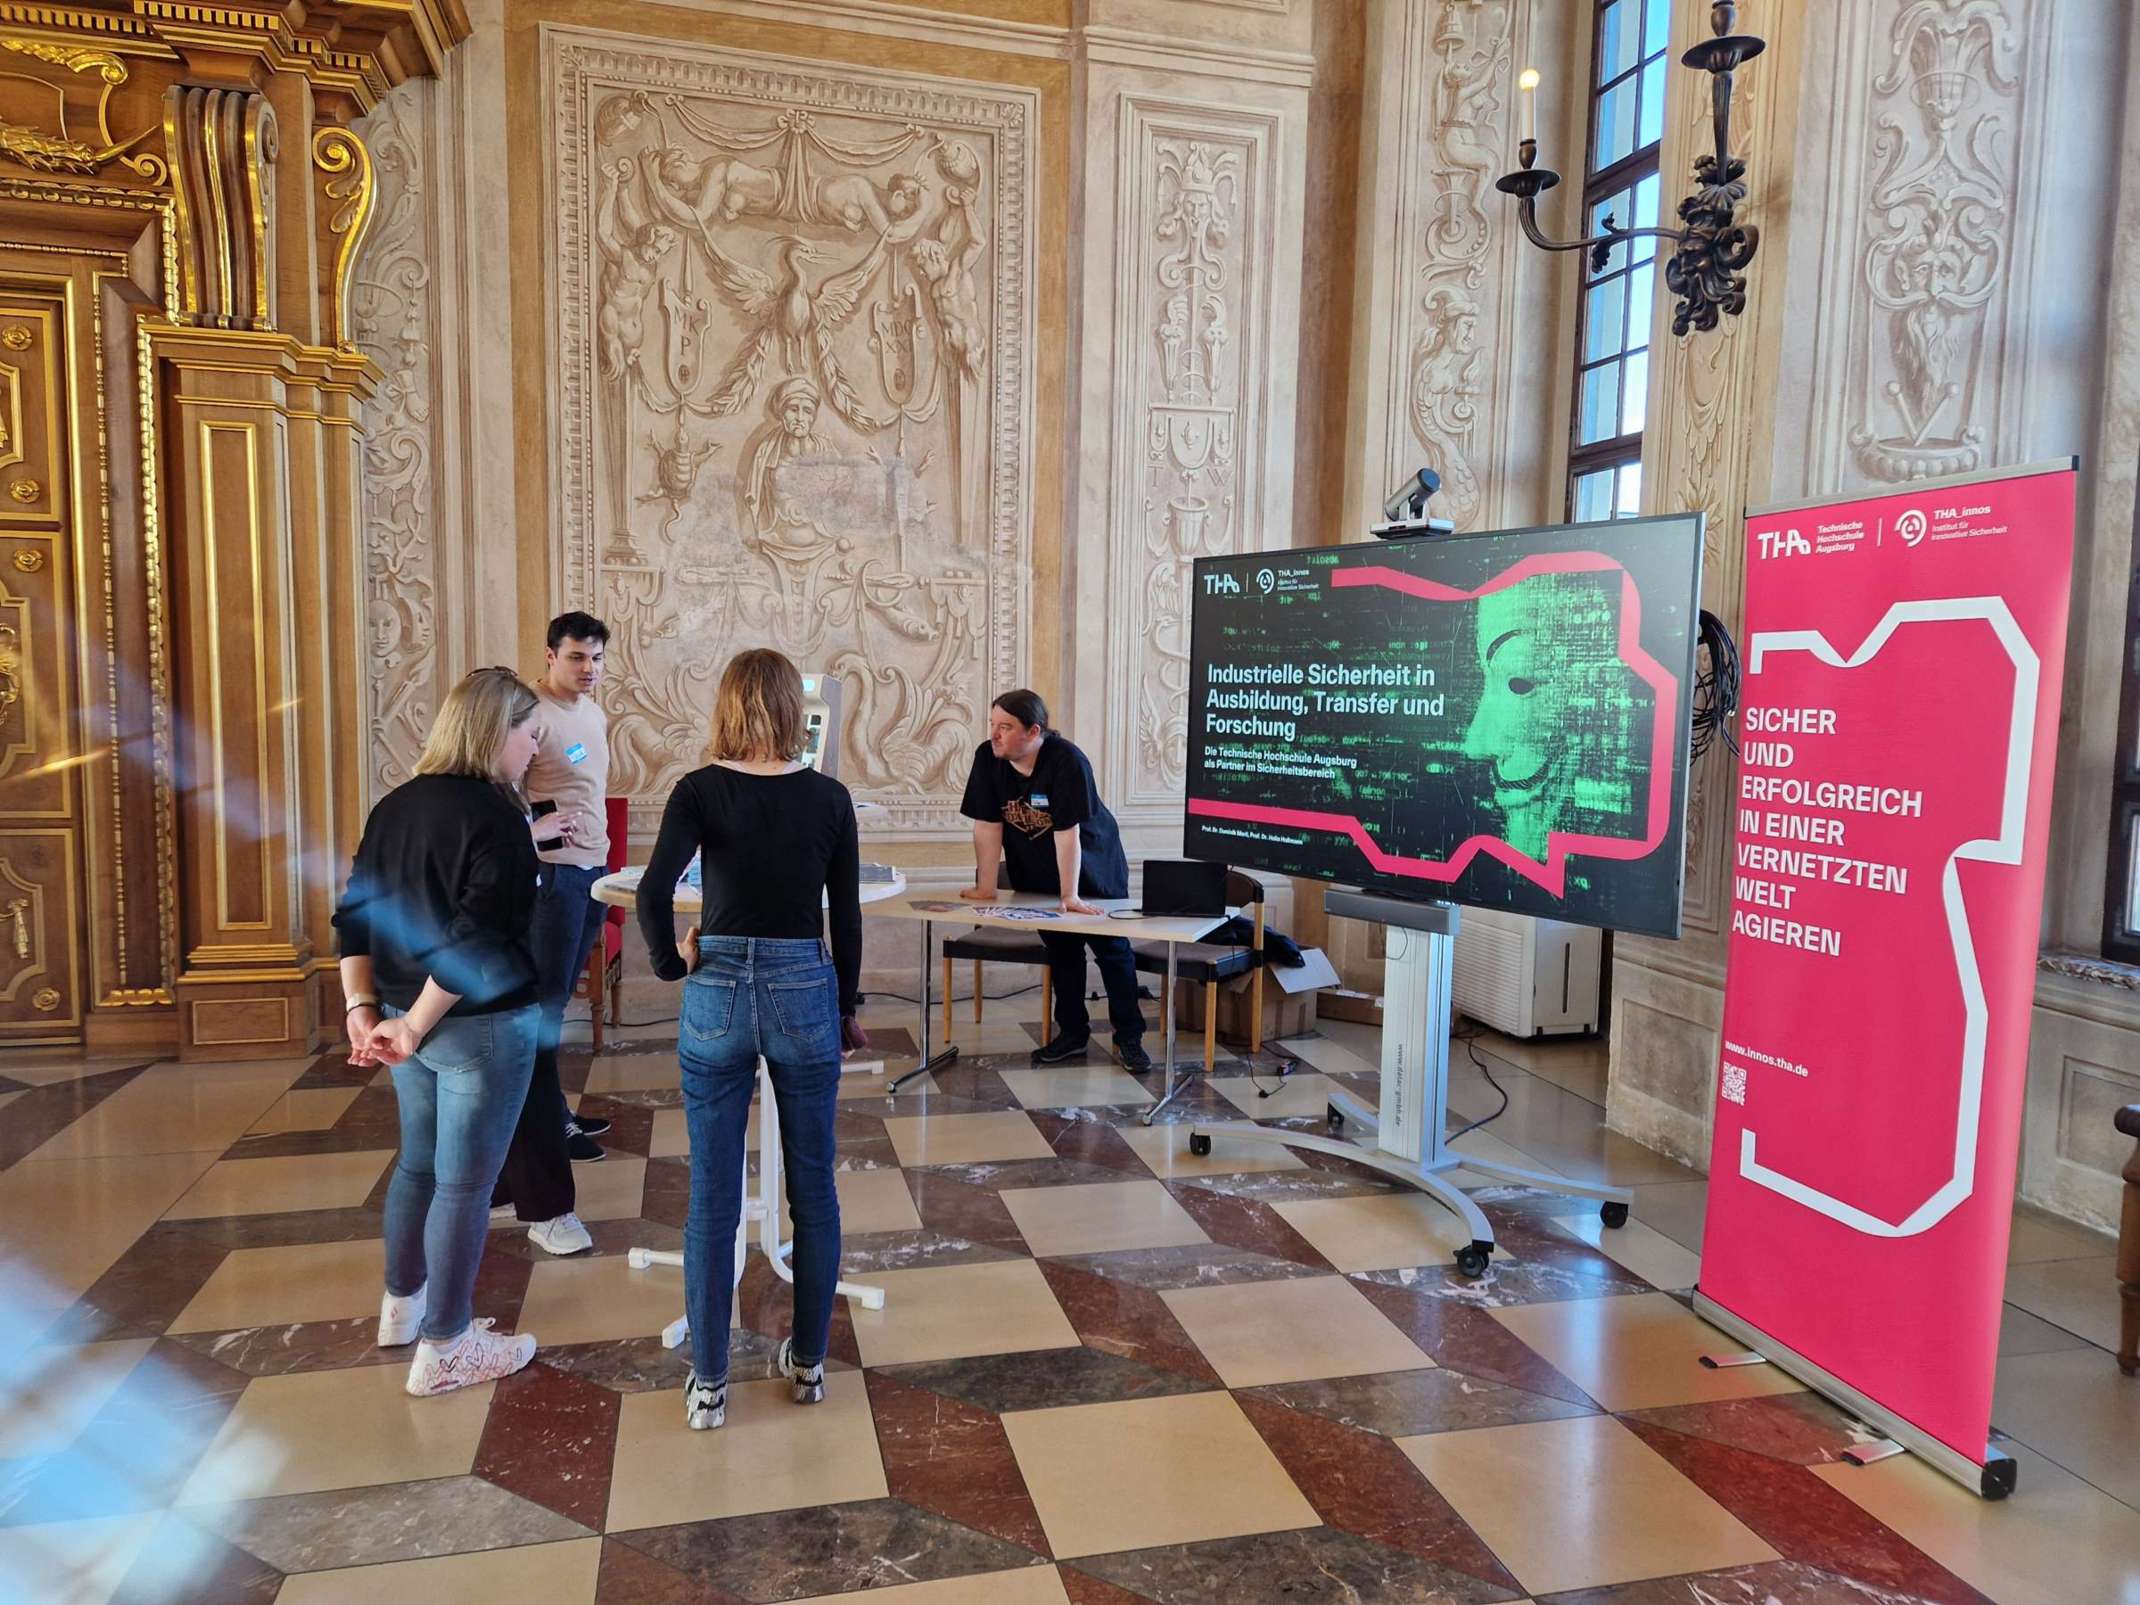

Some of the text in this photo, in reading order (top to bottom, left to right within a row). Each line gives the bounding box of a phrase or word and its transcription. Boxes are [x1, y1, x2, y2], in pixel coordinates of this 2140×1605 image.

[681, 336, 691, 355] P
[1933, 506, 1991, 520] THA_innos
[1817, 531, 1864, 543] Hochschule
[1818, 521, 1863, 533] Technische
[1816, 542, 1855, 554] Augsburg
[1207, 664, 1435, 686] Industrielle Sicherheit in
[1206, 689, 1444, 716] Ausbildung, Transfer und
[1206, 714, 1296, 741] Forschung
[1746, 707, 1837, 735] SICHER
[1205, 746, 1357, 769] Die Technische Hochschule Augsburg
[1744, 741, 1794, 768] UND
[1204, 760, 1335, 779] als Partner im Sicherheitsbereich
[1742, 775, 1923, 818] ERFOLGREICH
[1740, 809, 1845, 846] IN EINER
[1737, 842, 1908, 895] VERNETZTEN
[1735, 875, 1797, 910] WELT
[1732, 909, 1841, 957] AGIEREN
[1724, 1040, 1809, 1077] www.innos.tha.de
